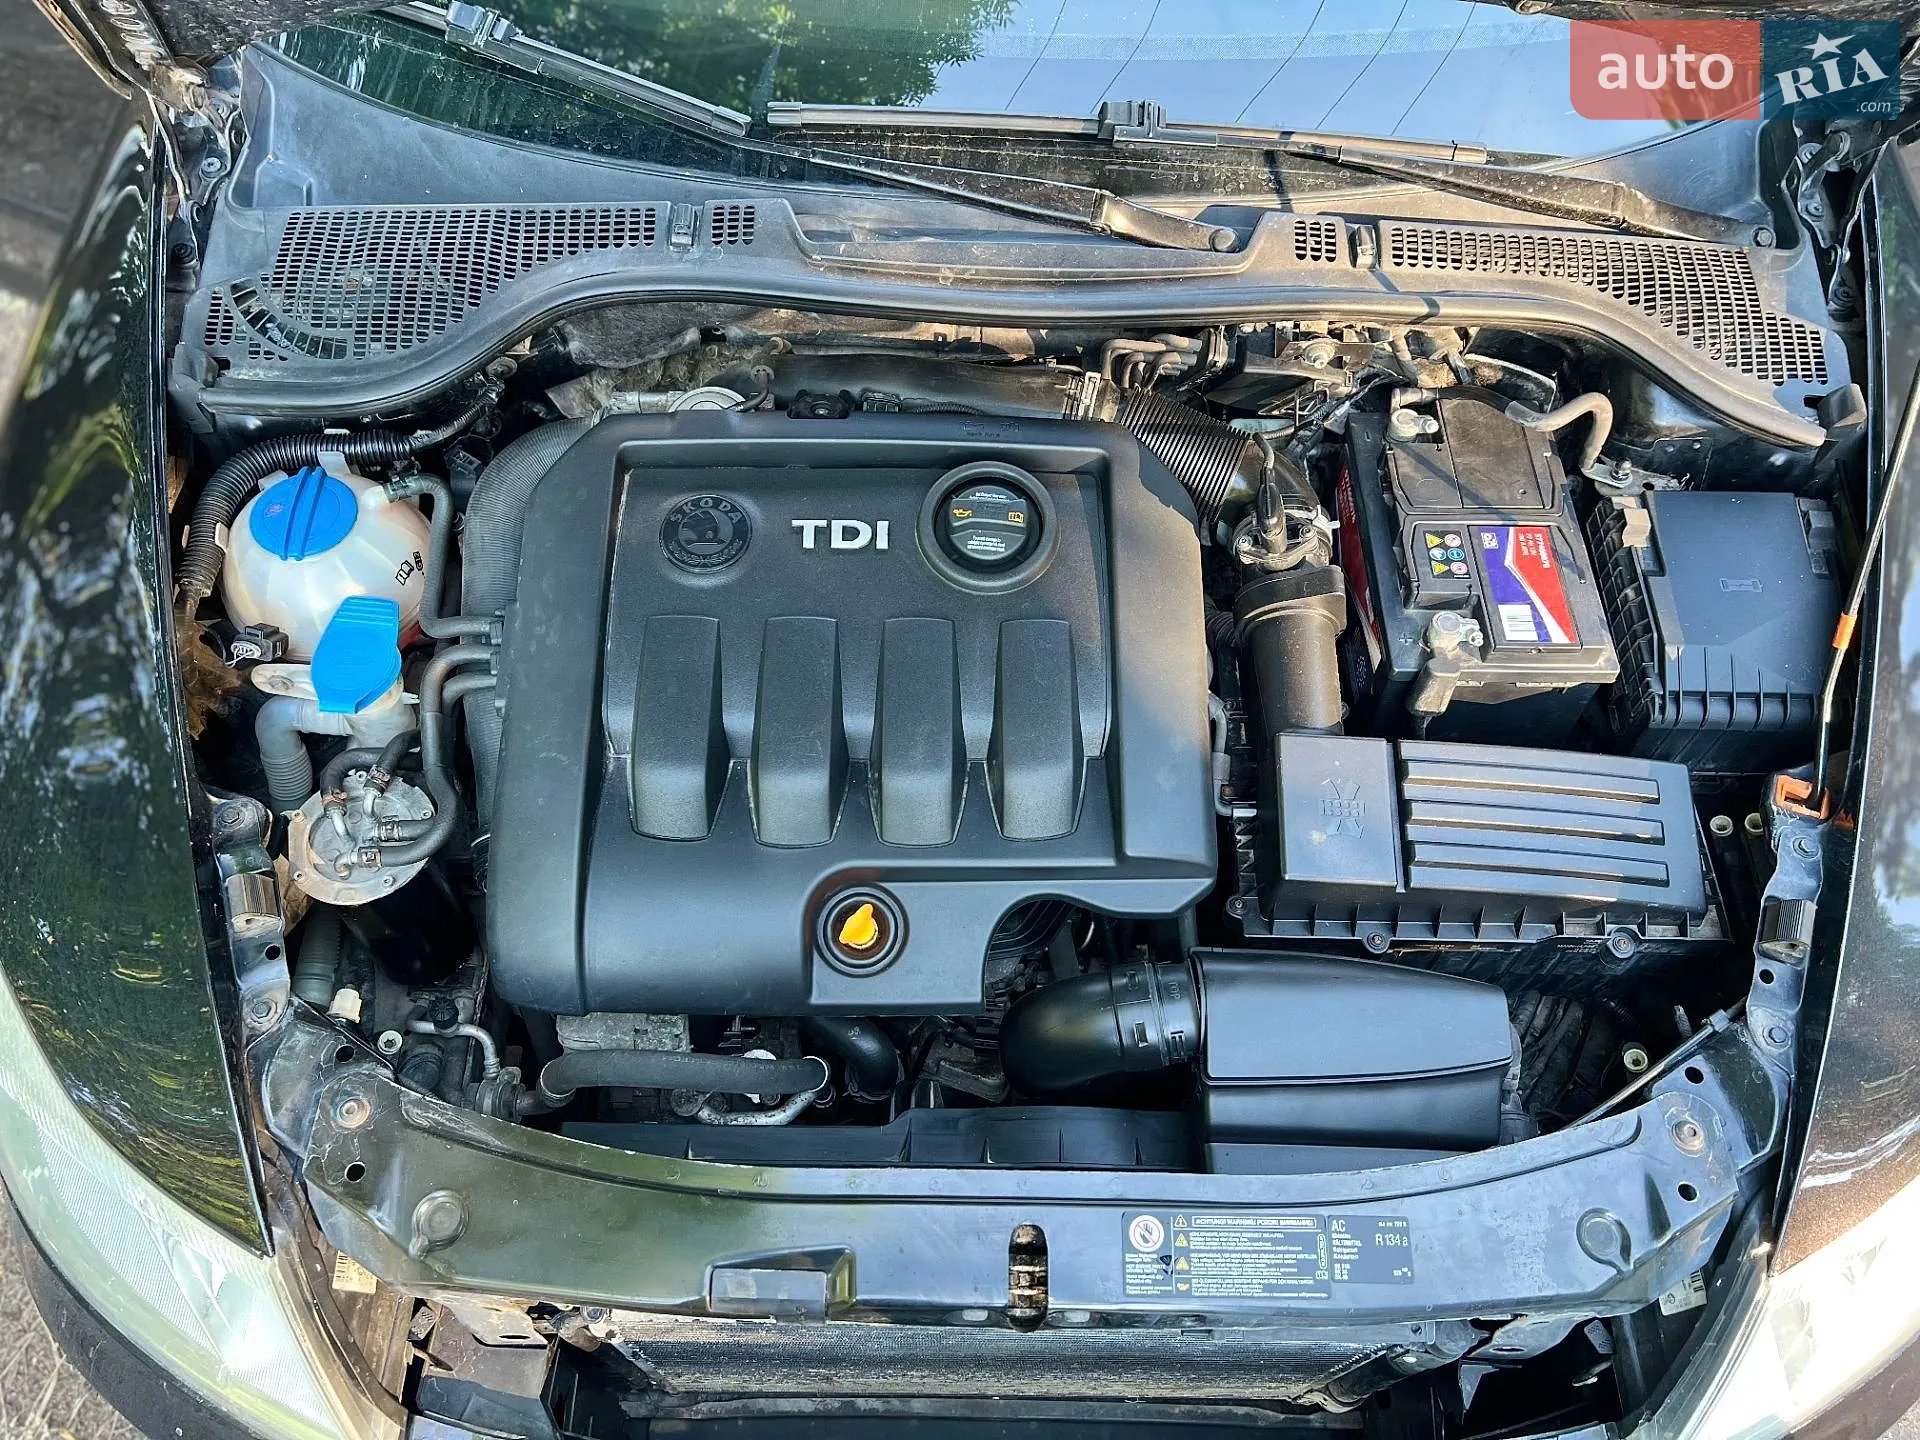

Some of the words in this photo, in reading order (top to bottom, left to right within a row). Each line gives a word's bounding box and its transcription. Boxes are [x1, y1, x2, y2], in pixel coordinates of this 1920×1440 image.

[791, 518, 890, 550] TDI
[1331, 1219, 1346, 1232] AC
[1375, 1233, 1384, 1246] R
[1384, 1233, 1401, 1246] 134
